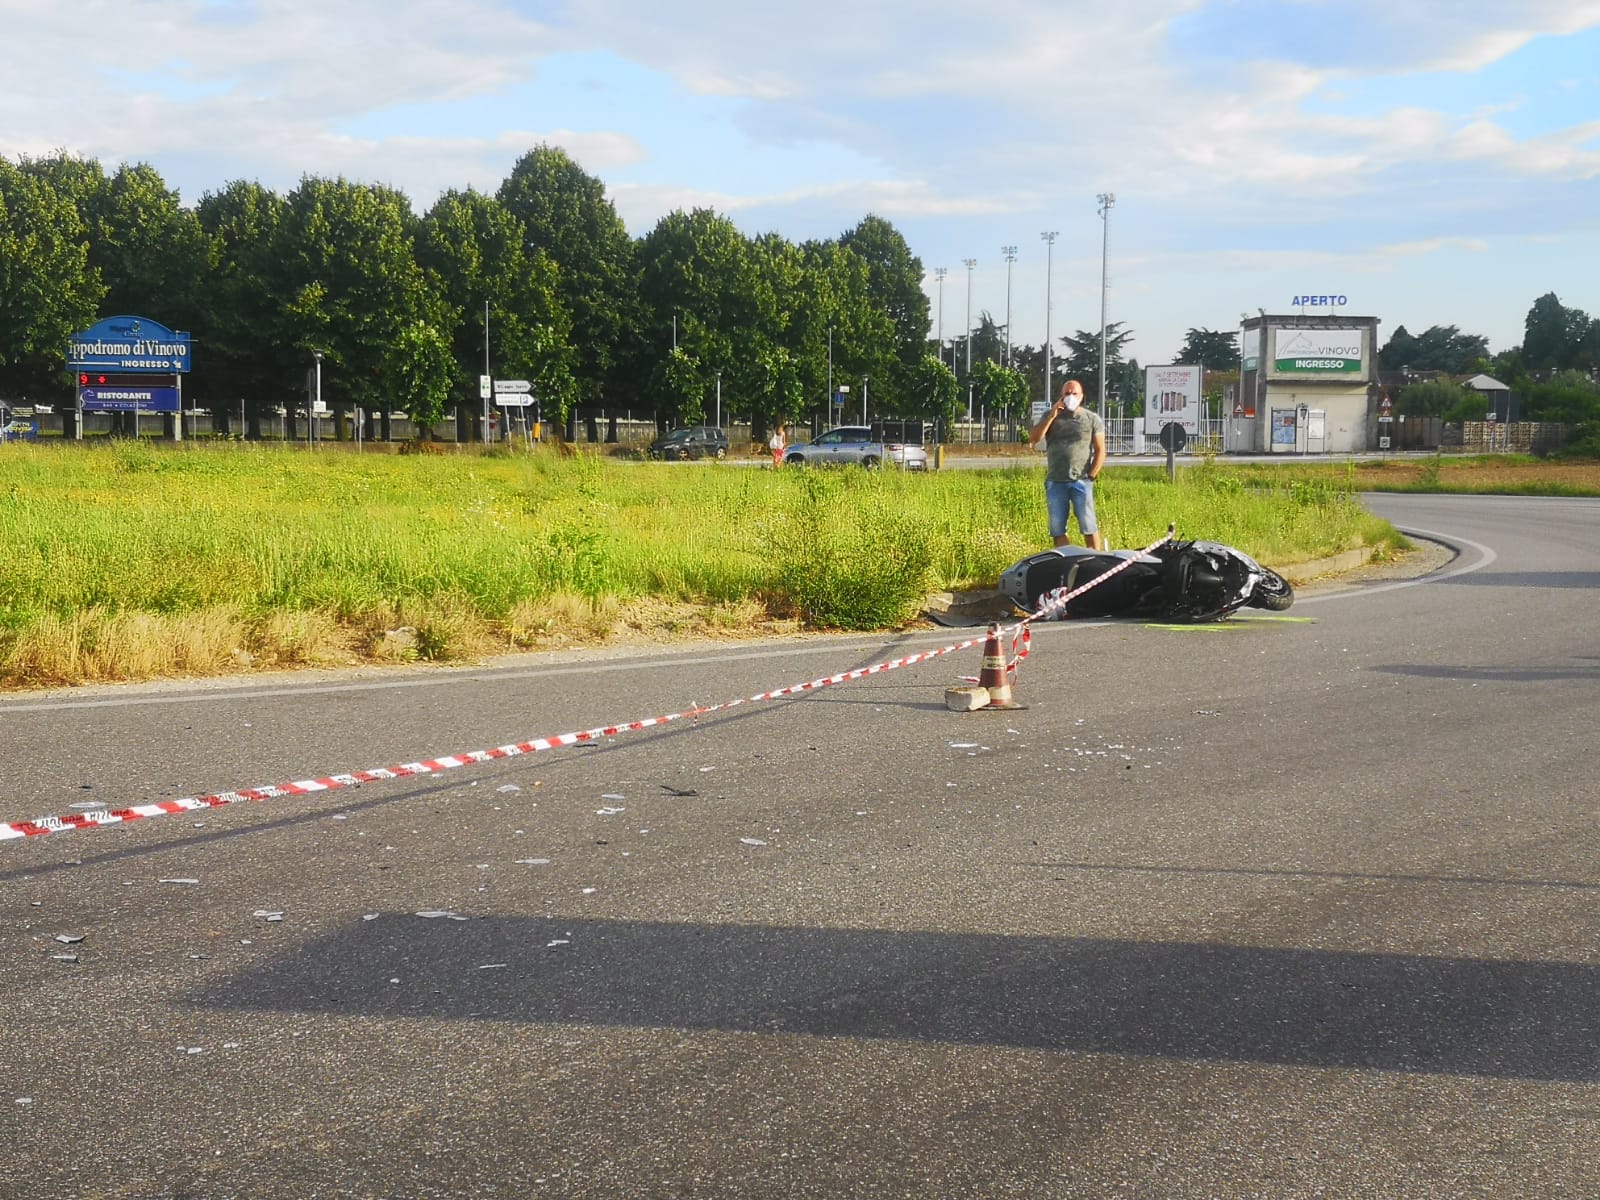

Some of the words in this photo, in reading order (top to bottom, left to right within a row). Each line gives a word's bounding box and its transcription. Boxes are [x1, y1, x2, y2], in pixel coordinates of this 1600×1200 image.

[1292, 295, 1347, 306] APERTO
[133, 339, 145, 356] di
[146, 340, 186, 356] Vinovo
[1318, 346, 1359, 355] VINOVO
[121, 360, 170, 368] INGRESSO
[1295, 360, 1344, 368] INGRESSO
[97, 392, 152, 400] RISTORANTE
